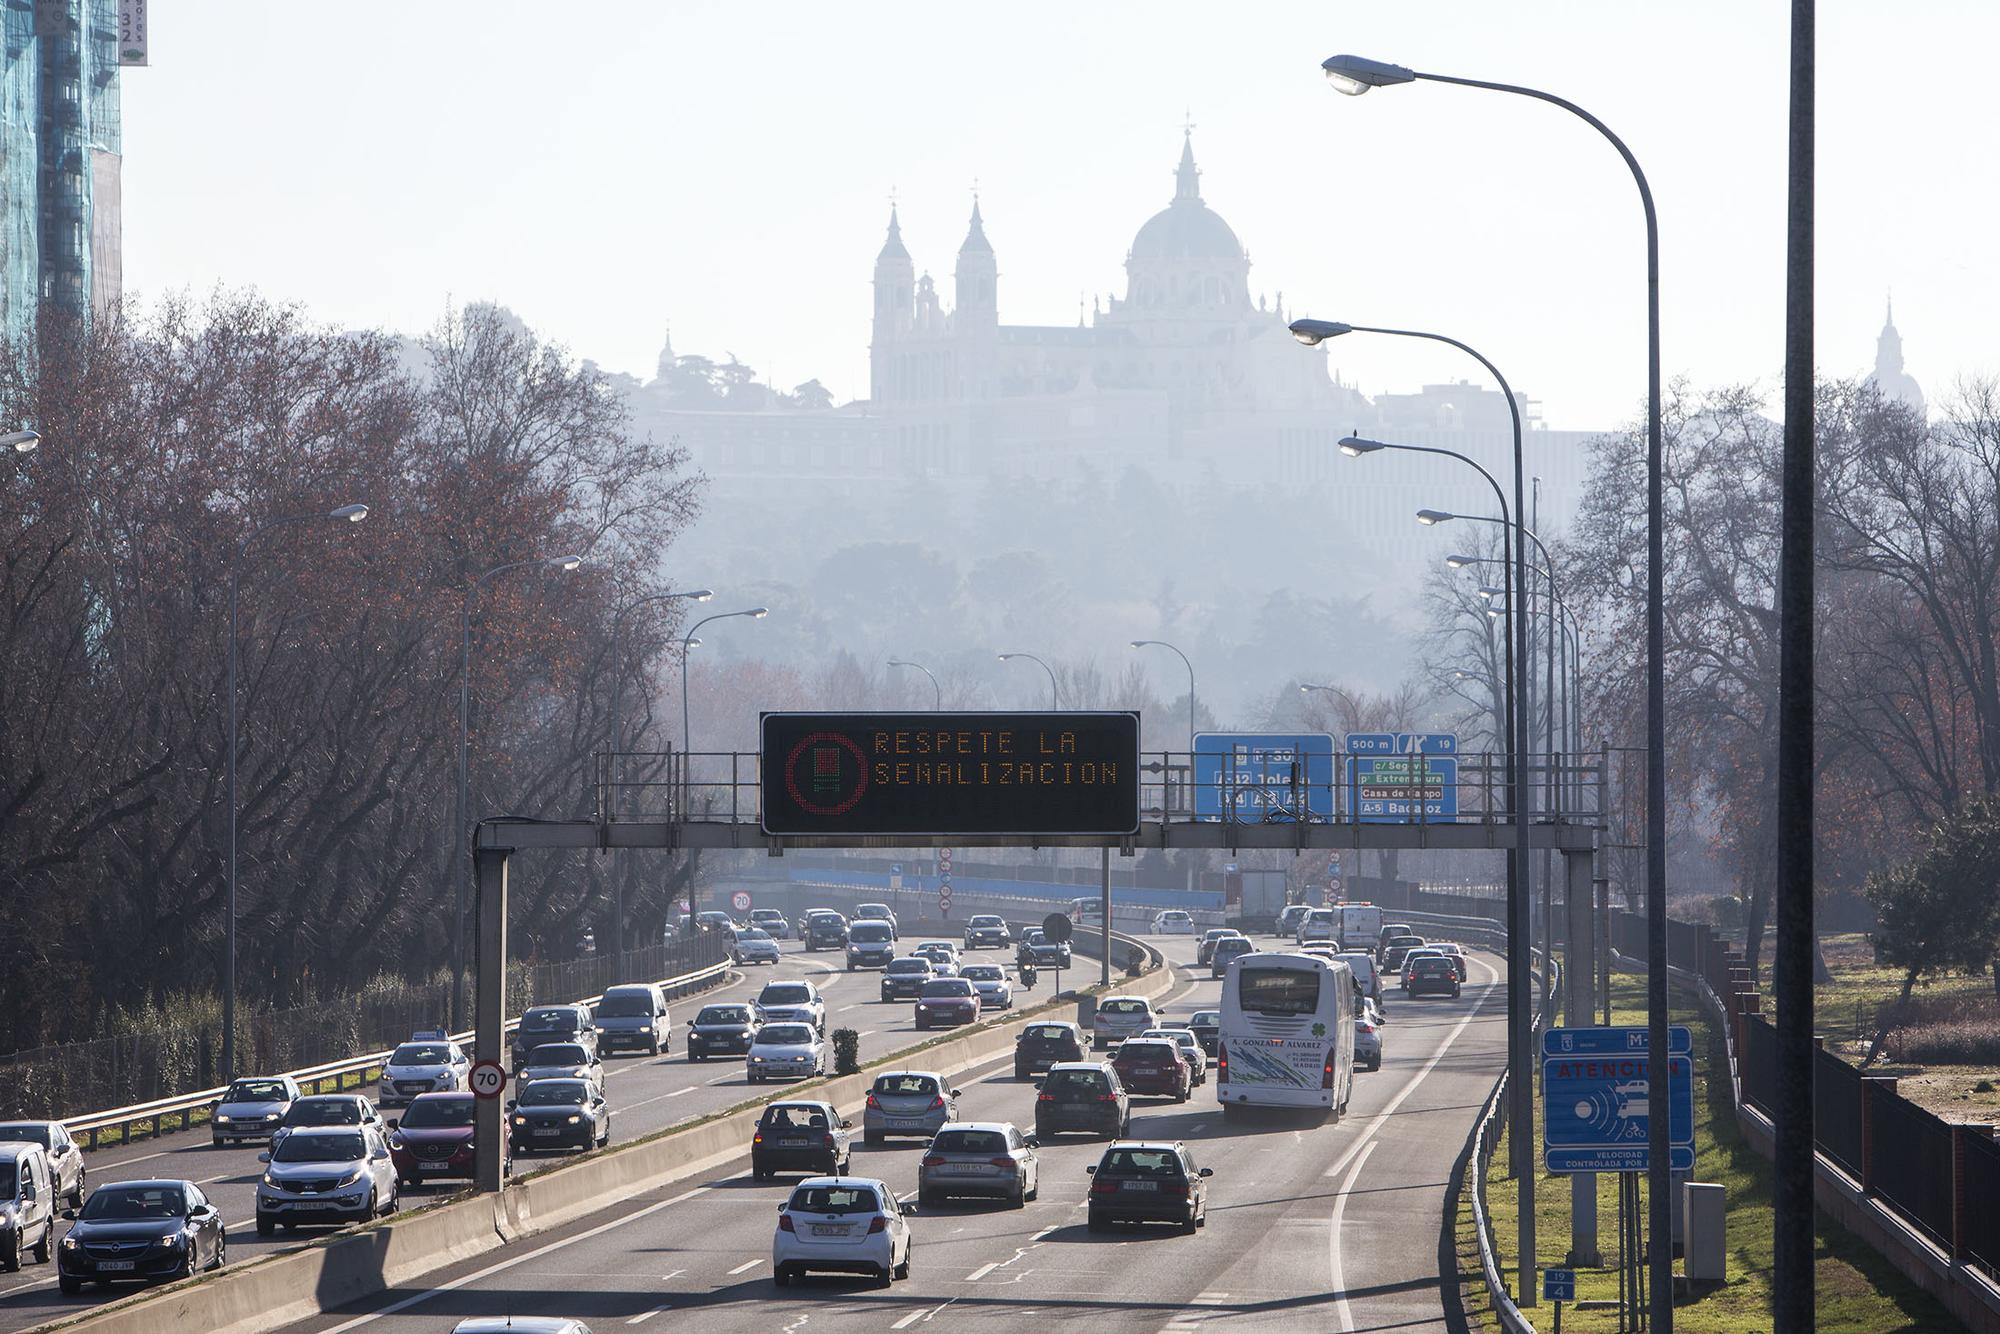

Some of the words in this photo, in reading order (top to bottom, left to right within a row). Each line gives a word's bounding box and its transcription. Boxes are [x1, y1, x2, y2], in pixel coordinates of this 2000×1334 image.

[874, 731, 1015, 754] RESPETE
[1039, 731, 1077, 754] LA
[1352, 740, 1375, 749] 500
[1379, 741, 1389, 749] m
[1438, 740, 1451, 749] 19
[1362, 789, 1388, 798] Casa
[1391, 789, 1404, 798] de
[1363, 803, 1382, 812] A-5
[737, 896, 748, 906] 70
[1286, 1041, 1322, 1049] ALVAREZ
[1558, 1061, 1679, 1078] ATENCIN
[477, 1072, 498, 1086] 70
[1595, 1151, 1643, 1160] VELOCIDAD
[1565, 1160, 1622, 1168] CONTROLADA
[1625, 1160, 1643, 1168] POR
[1553, 1272, 1565, 1281] 19
[1553, 1286, 1564, 1297] 4
